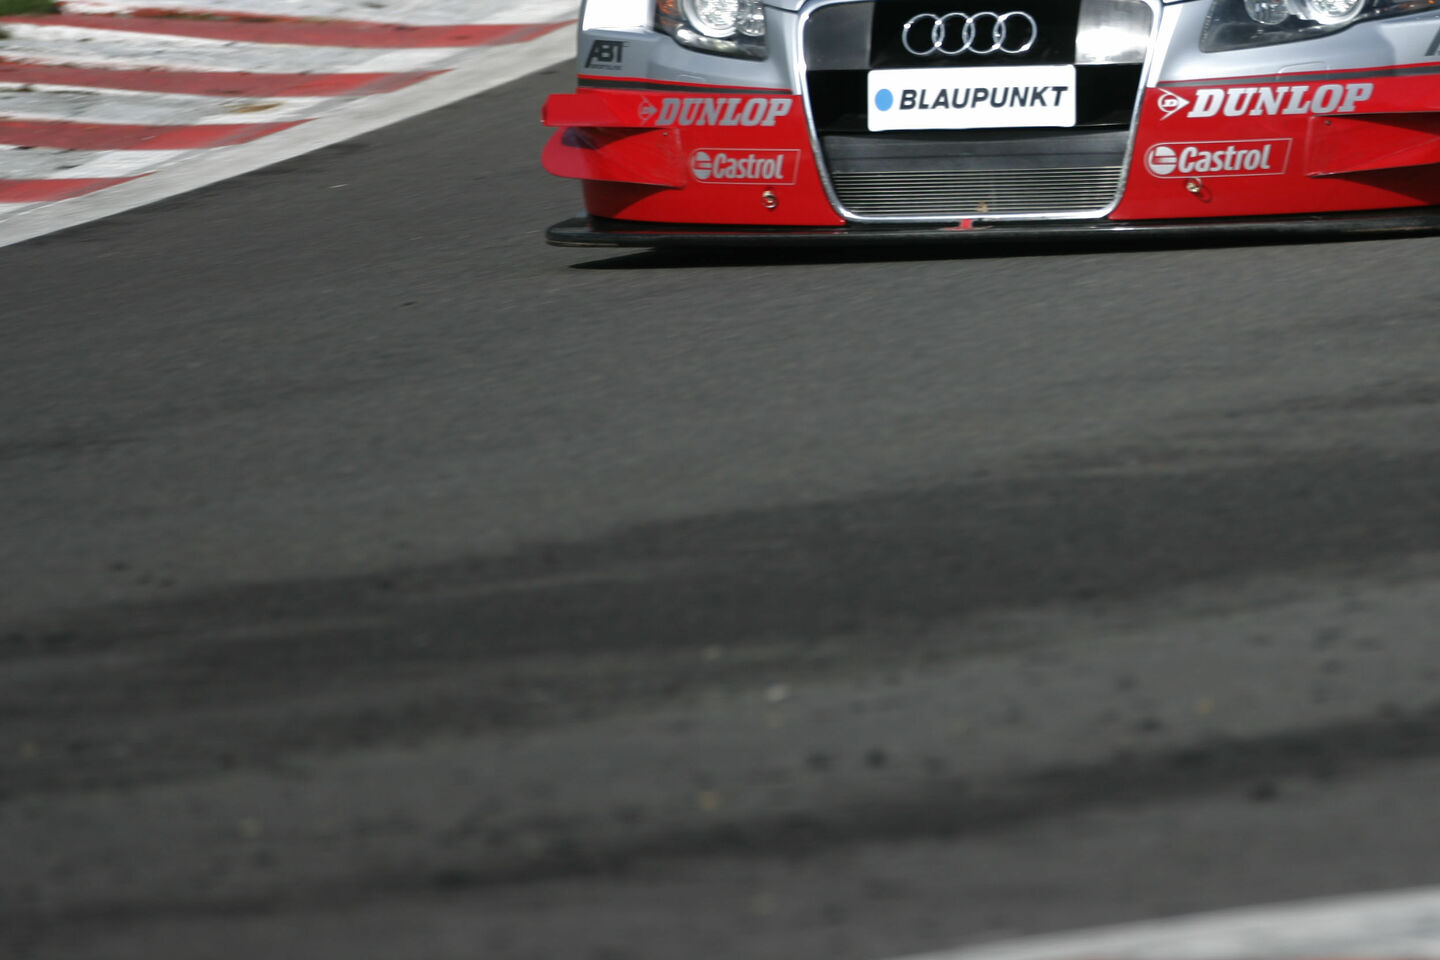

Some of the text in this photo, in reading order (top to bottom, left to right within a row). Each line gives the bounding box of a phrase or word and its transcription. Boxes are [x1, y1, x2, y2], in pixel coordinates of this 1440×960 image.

[585, 40, 623, 69] ABT
[655, 97, 793, 127] DUNLOP
[899, 86, 1068, 110] BLAUPUNKT
[1187, 83, 1374, 118] DUNLOP
[713, 153, 785, 179] Castrol
[1178, 144, 1272, 173] Castrol
